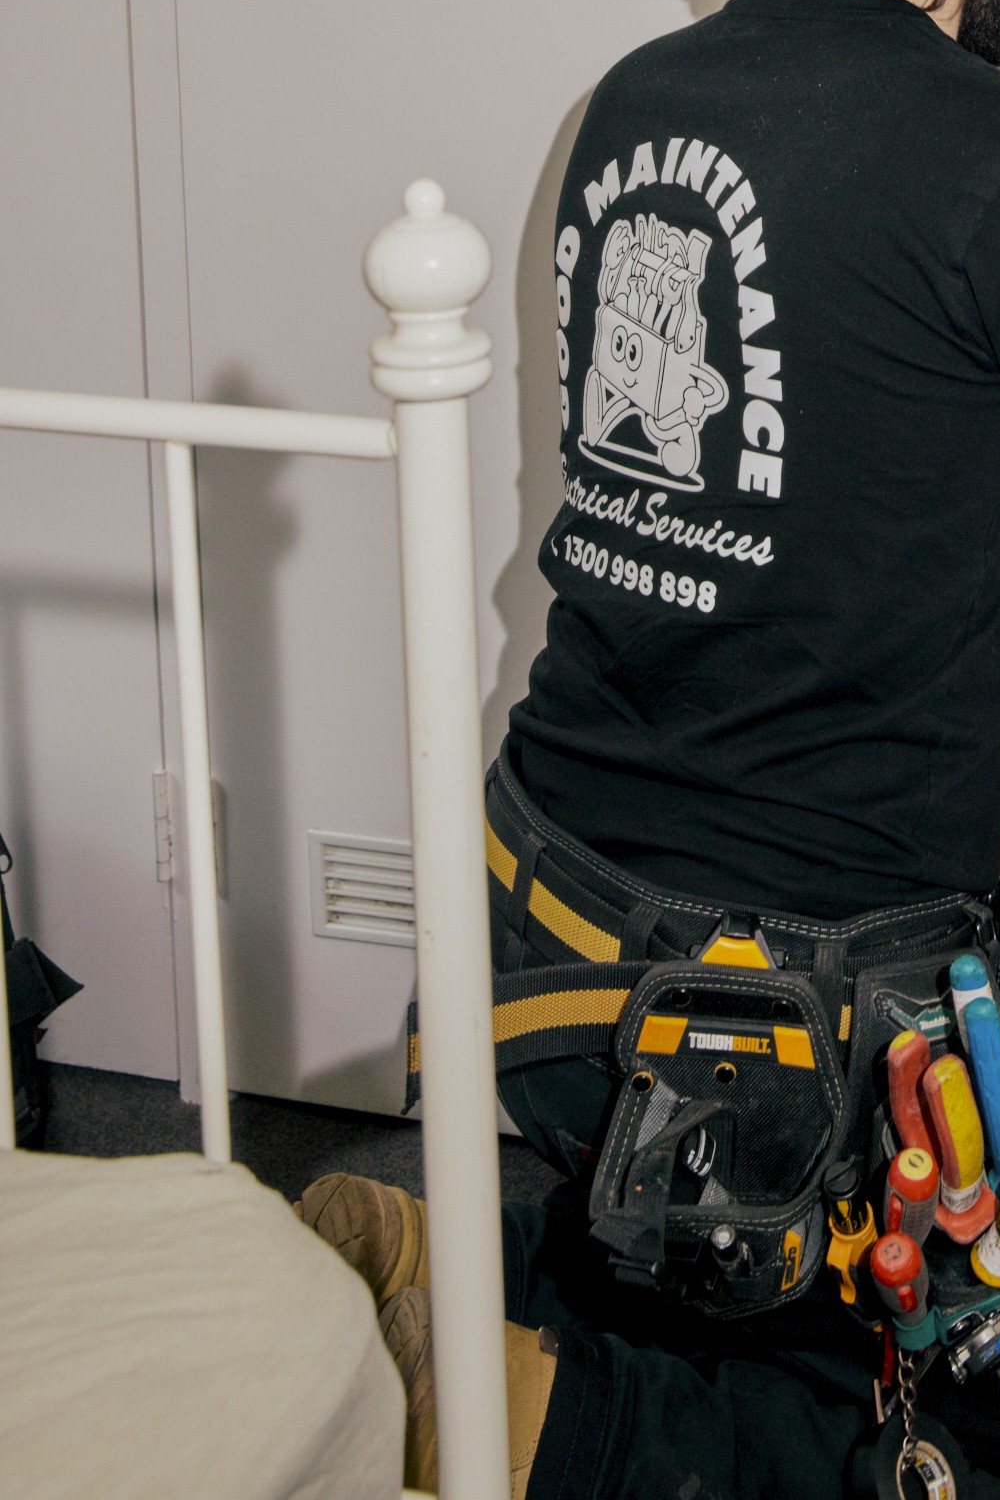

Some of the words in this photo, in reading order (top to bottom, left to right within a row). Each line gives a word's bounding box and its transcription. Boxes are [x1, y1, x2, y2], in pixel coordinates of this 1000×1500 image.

[583, 137, 787, 499] MAINTENANCE
[636, 492, 775, 566] Services
[563, 534, 609, 579] 1300
[610, 554, 654, 597] 998
[659, 571, 718, 613] 898
